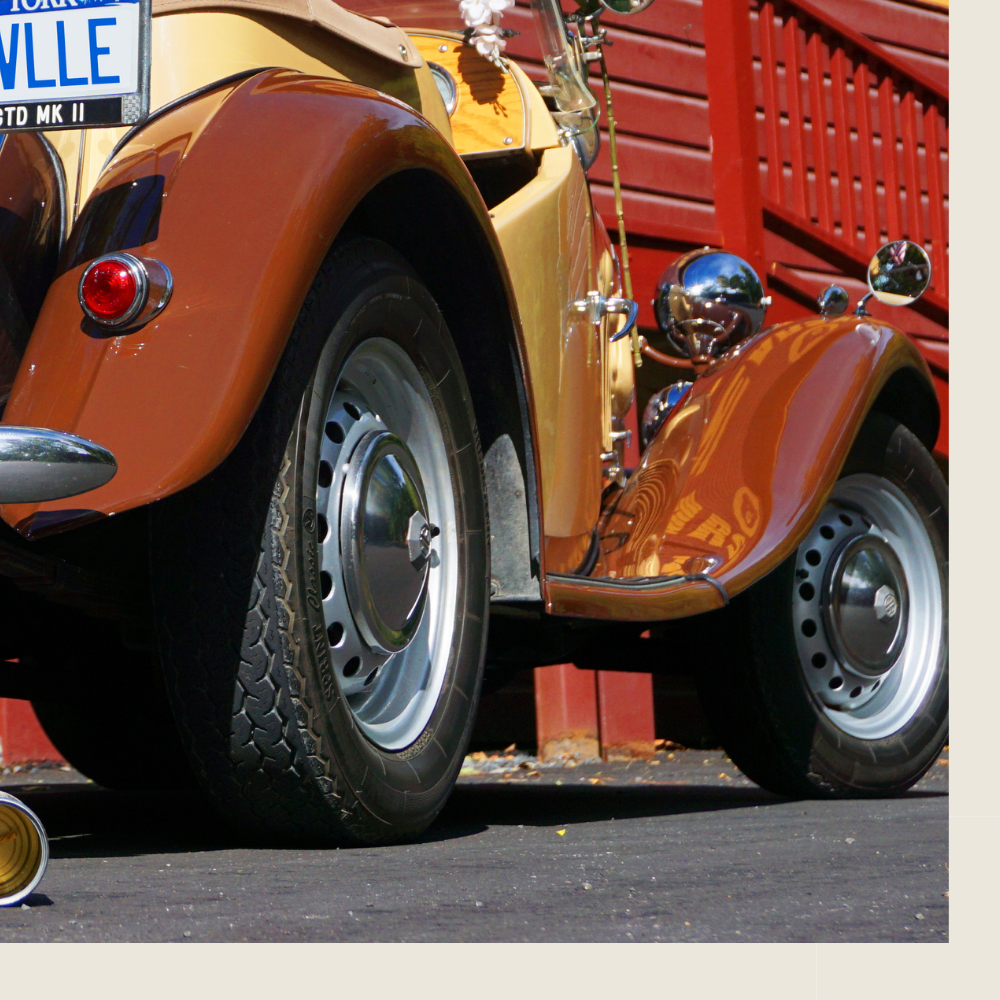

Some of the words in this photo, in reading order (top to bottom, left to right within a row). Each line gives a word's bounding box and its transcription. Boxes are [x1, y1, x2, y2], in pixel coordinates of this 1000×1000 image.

[36, 105, 63, 124] MK
[72, 102, 85, 123] II
[313, 624, 335, 701] SPRINT
